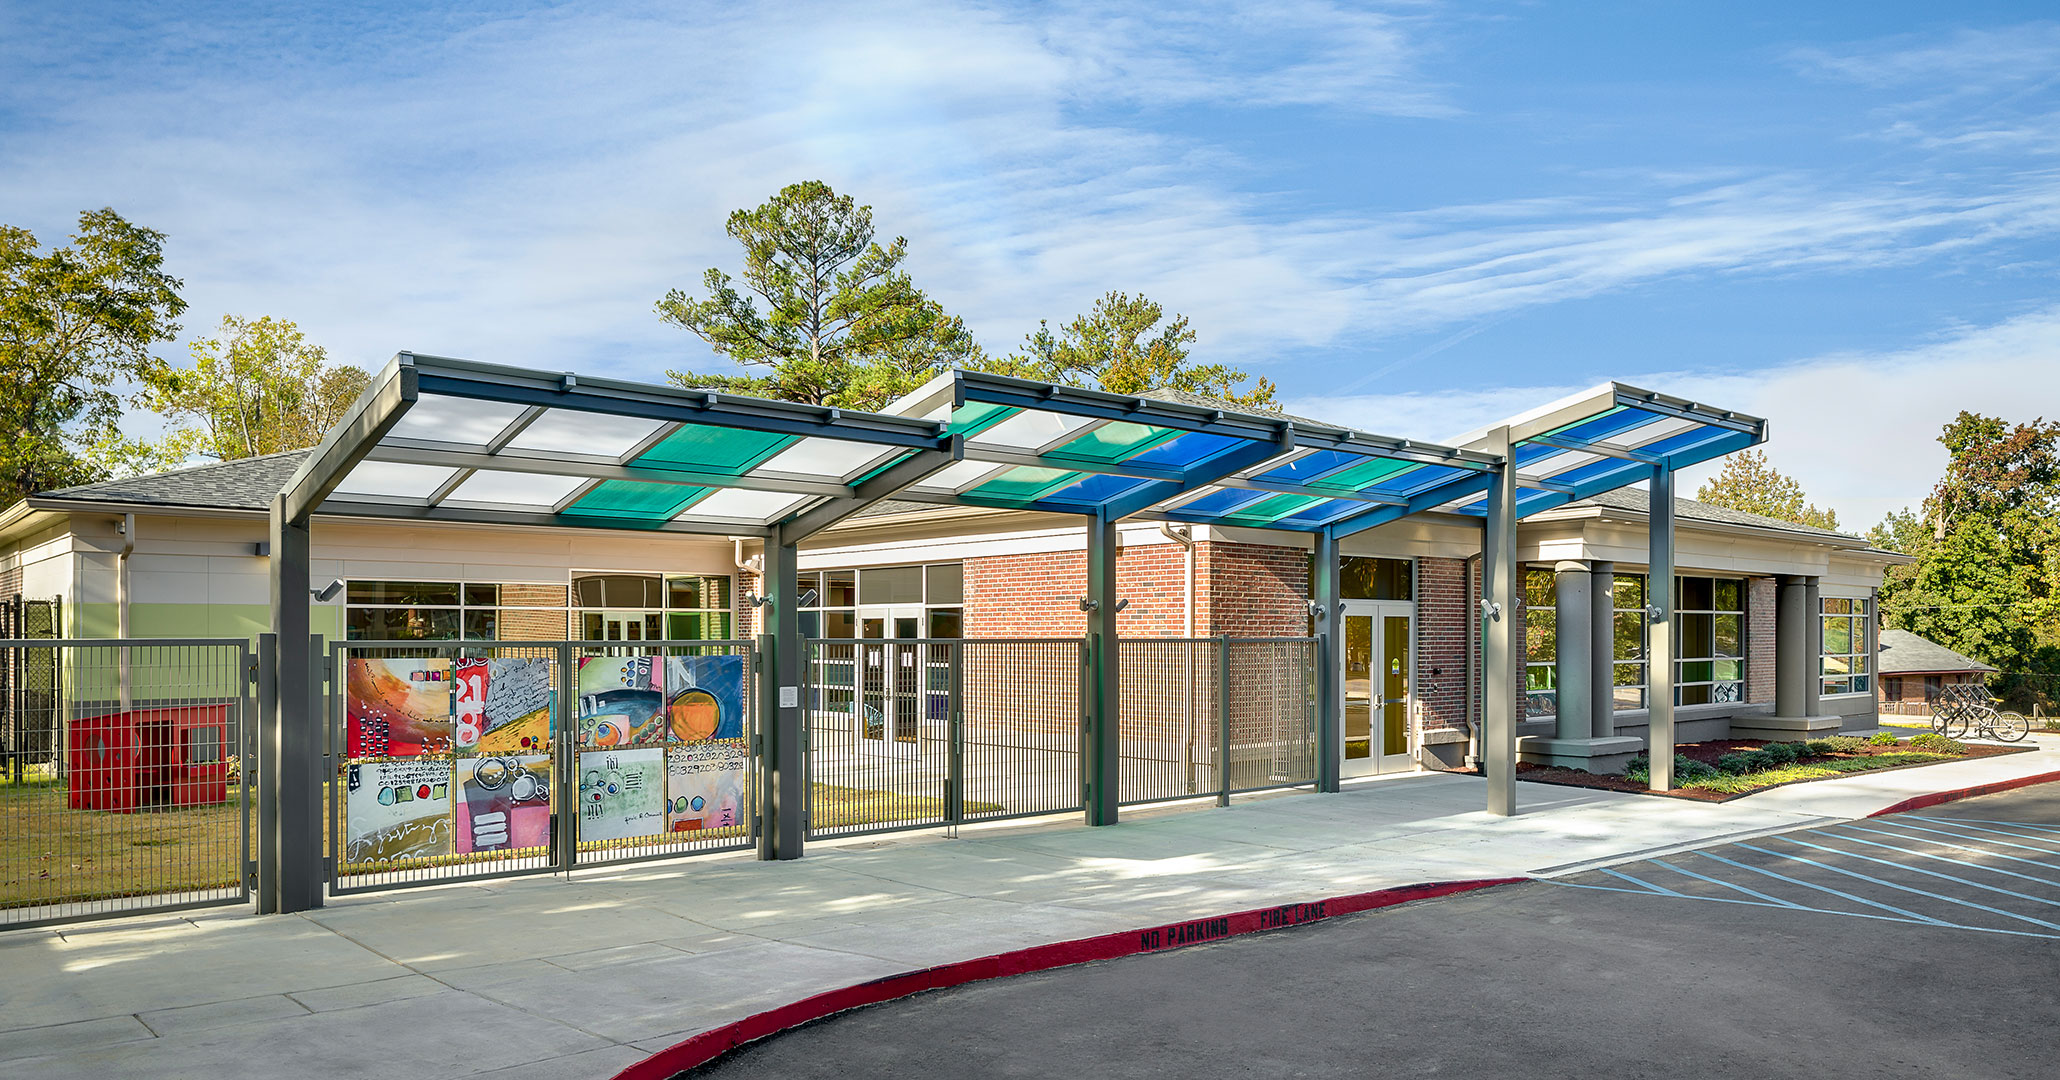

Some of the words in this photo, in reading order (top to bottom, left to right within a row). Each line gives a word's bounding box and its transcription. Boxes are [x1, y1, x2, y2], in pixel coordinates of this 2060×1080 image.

[1260, 906, 1289, 928] FIRE
[1295, 902, 1326, 923] LANE
[1141, 930, 1160, 951] NO
[1167, 917, 1228, 947] PARKING
